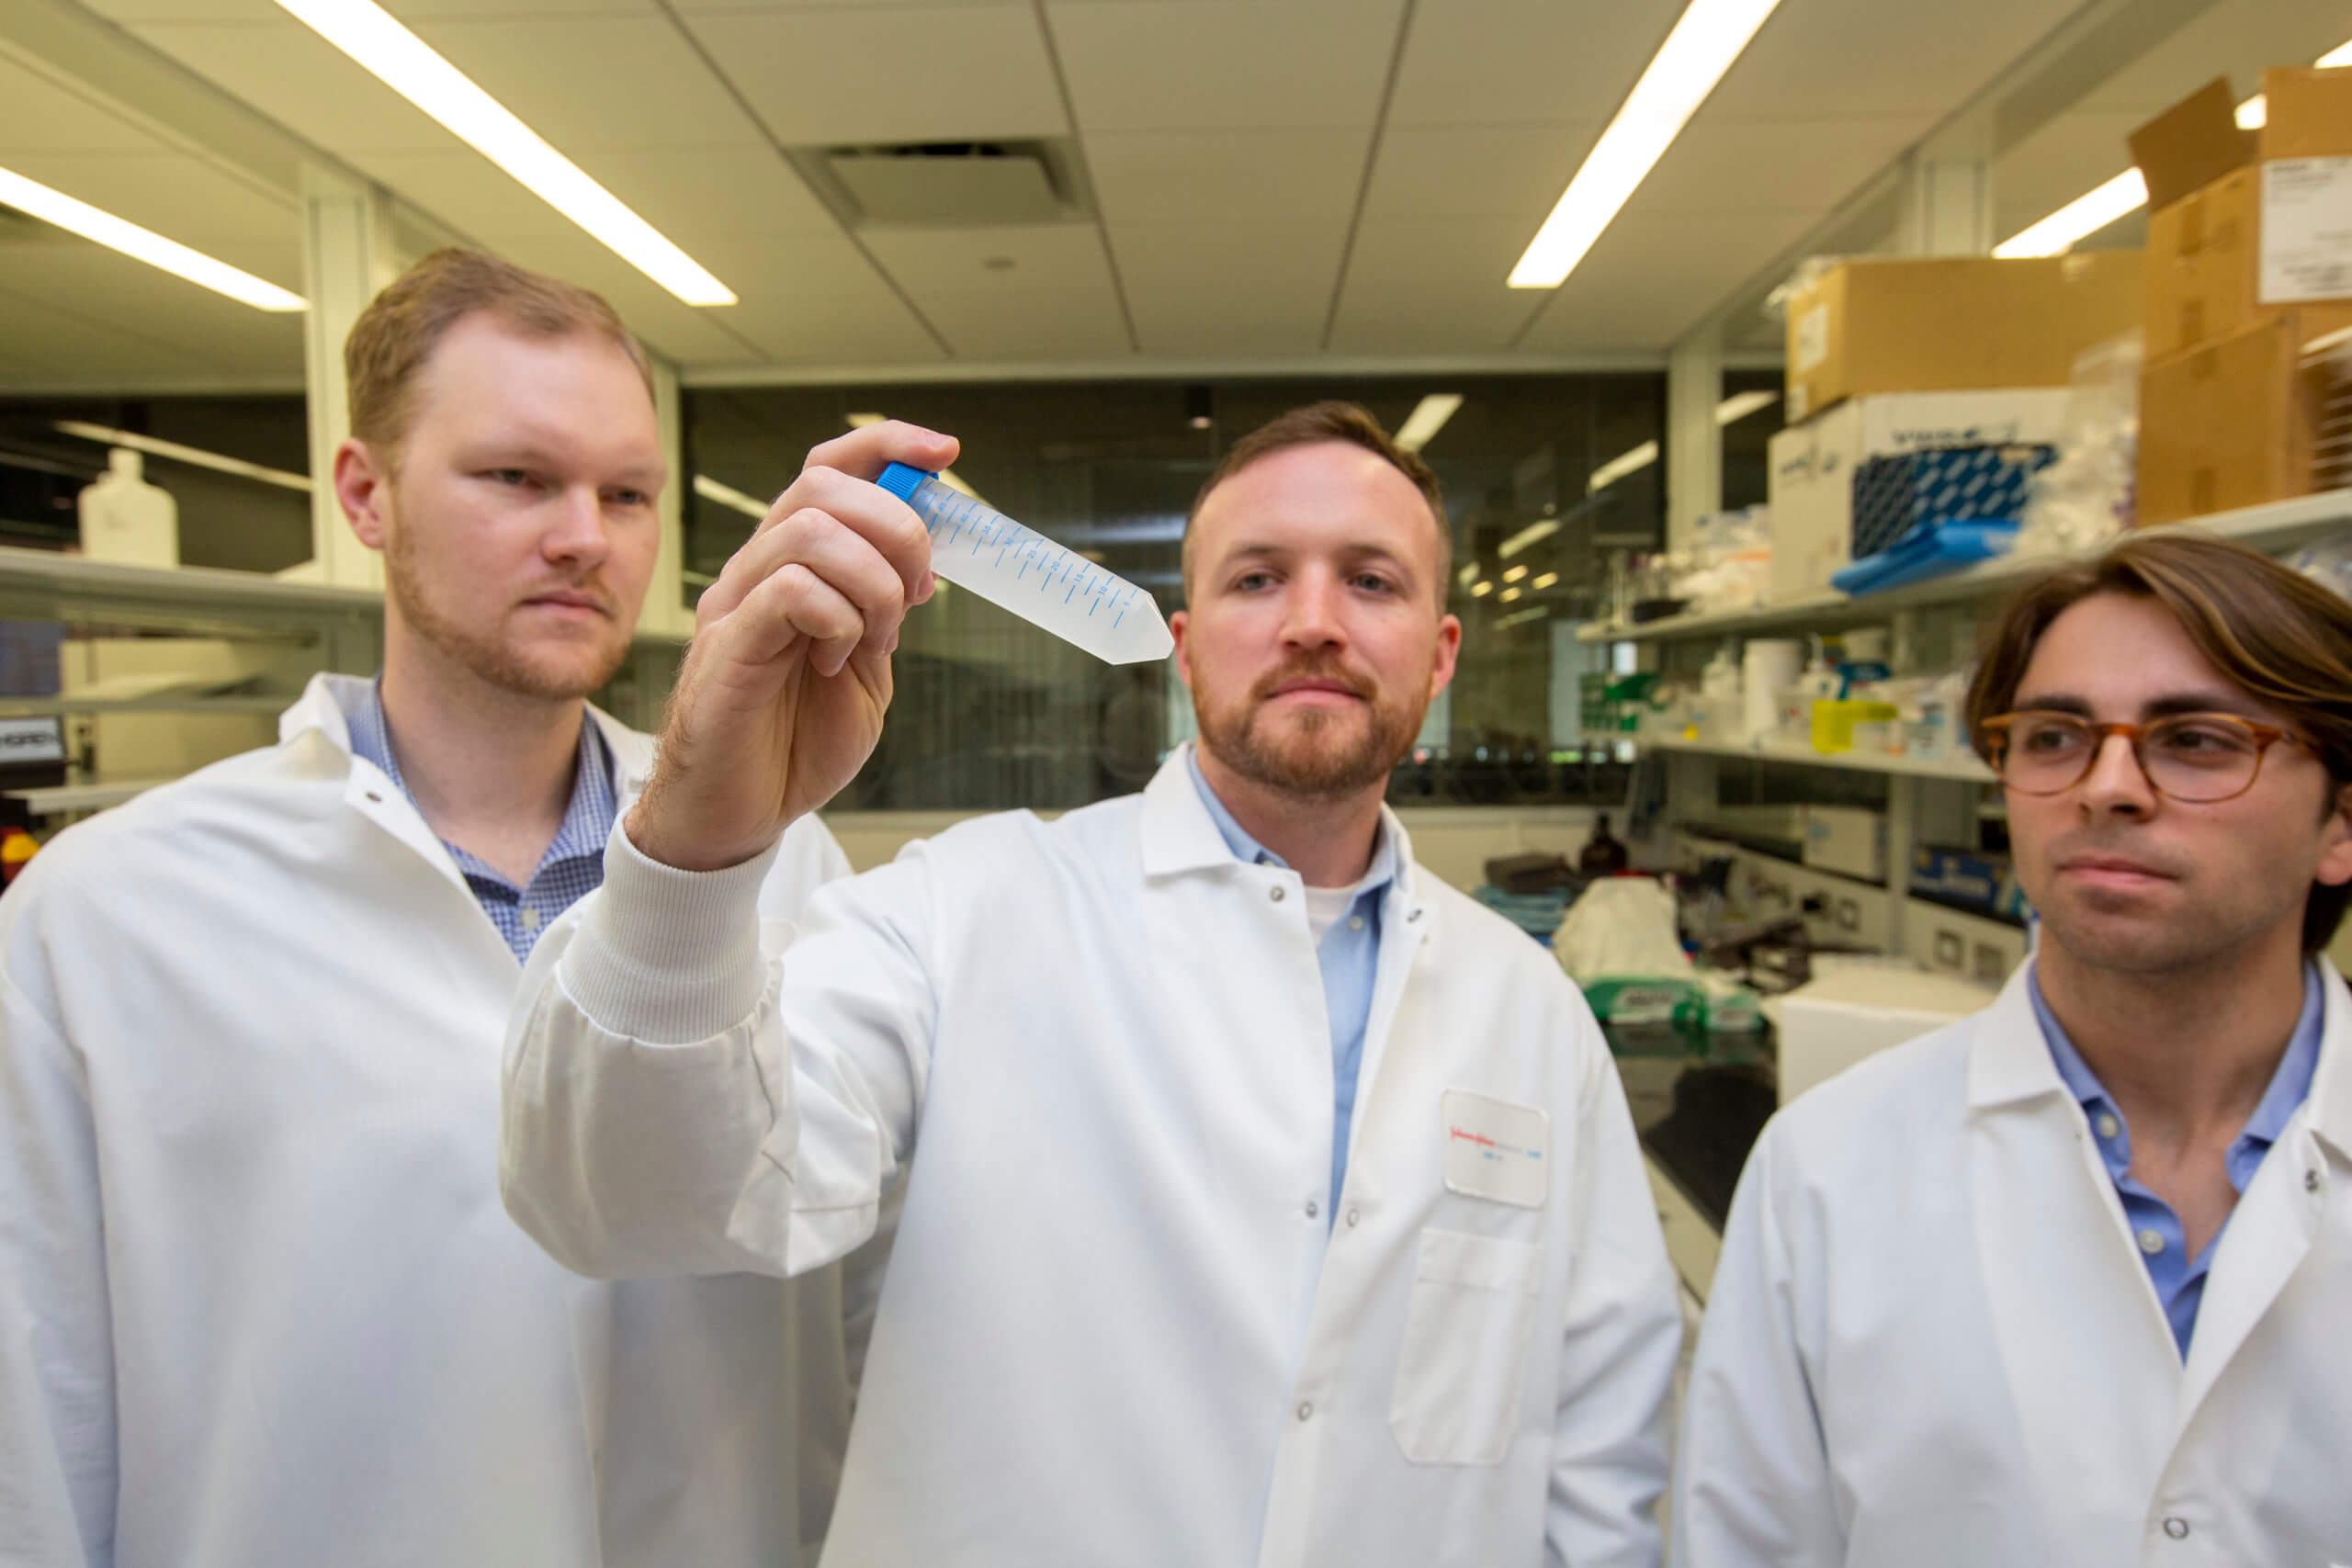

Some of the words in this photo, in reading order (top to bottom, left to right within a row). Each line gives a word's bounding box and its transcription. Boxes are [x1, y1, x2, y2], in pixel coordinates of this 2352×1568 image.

[1026, 548, 1037, 559] 25
[1050, 560, 1061, 572] 20
[1073, 572, 1084, 583] 15
[1097, 585, 1109, 596] 10
